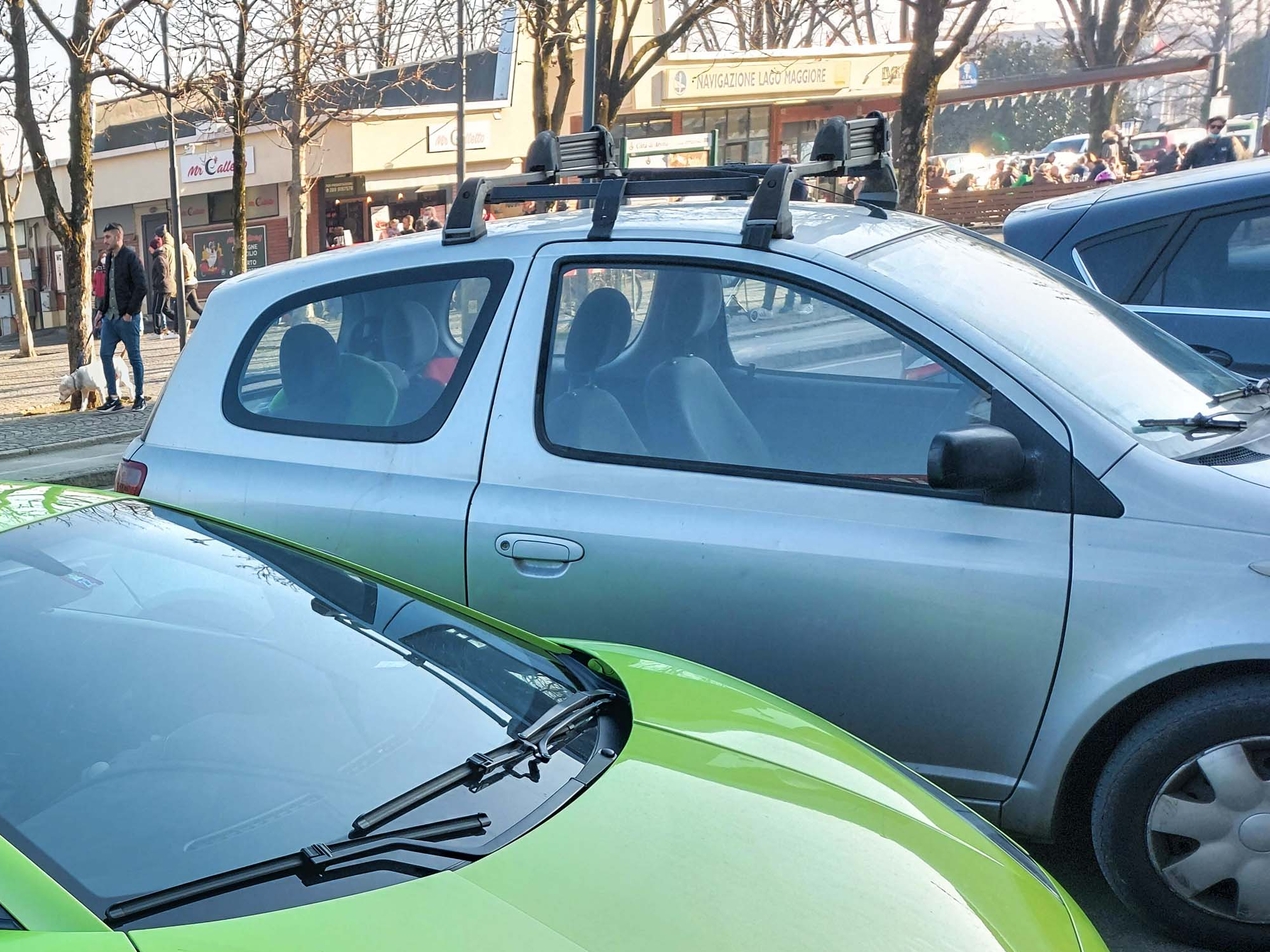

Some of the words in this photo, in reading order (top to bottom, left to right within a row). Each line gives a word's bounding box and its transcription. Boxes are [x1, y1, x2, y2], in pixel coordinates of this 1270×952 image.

[696, 72, 755, 90] NAVIGAZIONE
[758, 70, 781, 87] LAGO
[784, 68, 826, 85] MAGGIORE
[187, 165, 203, 177] Mr
